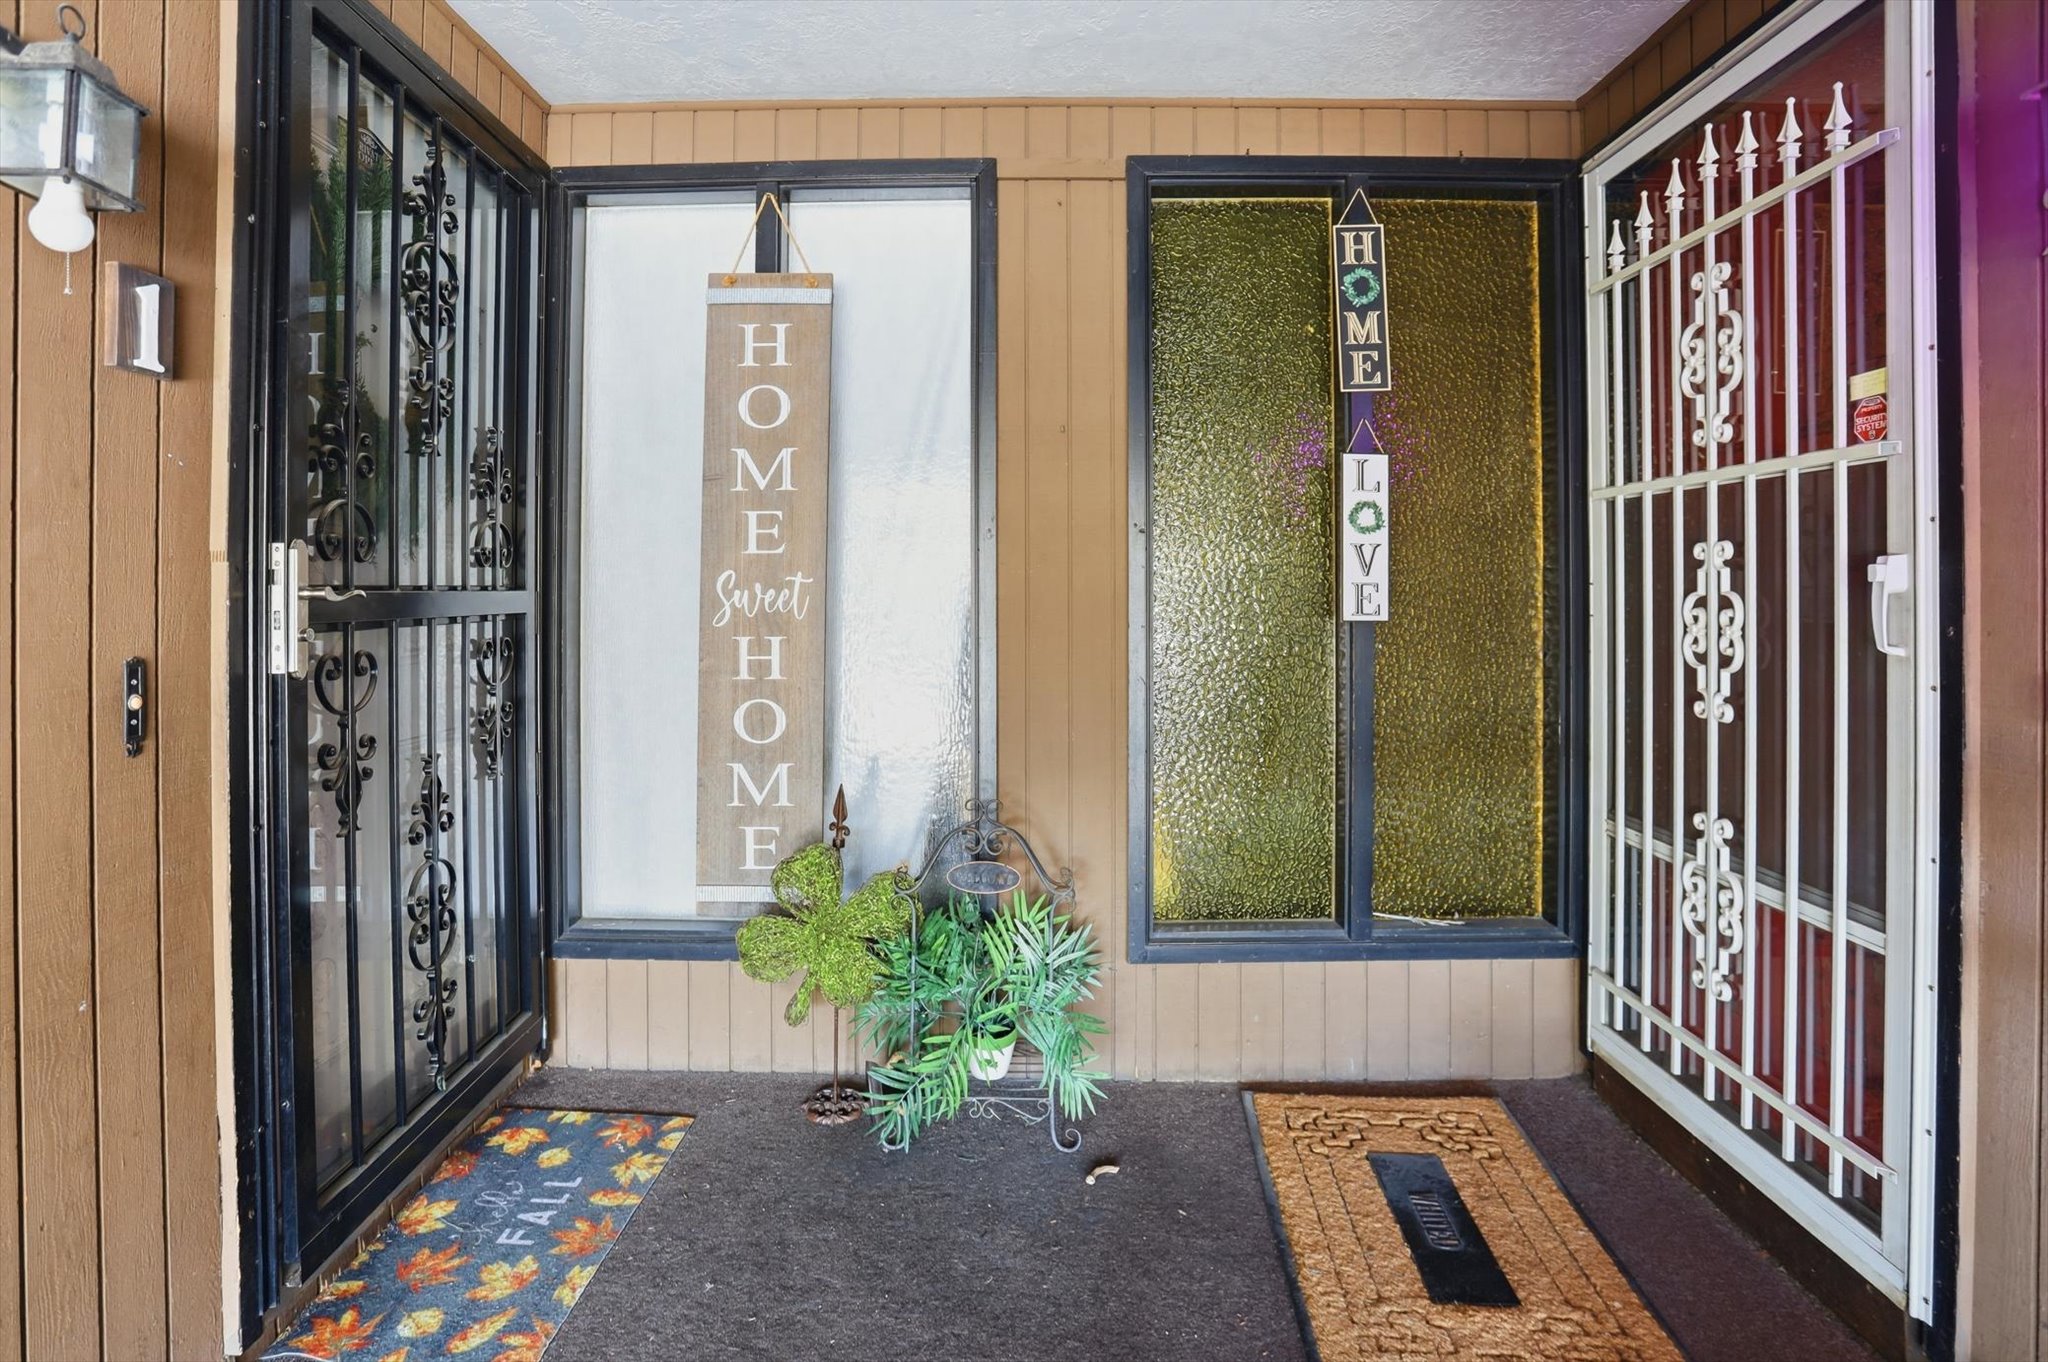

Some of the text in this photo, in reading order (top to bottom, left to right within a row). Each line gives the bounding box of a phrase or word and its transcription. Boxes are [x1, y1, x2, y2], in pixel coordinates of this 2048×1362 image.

[729, 322, 799, 556] HOME
[725, 635, 796, 871] HOME
[495, 1176, 584, 1246] FALL
